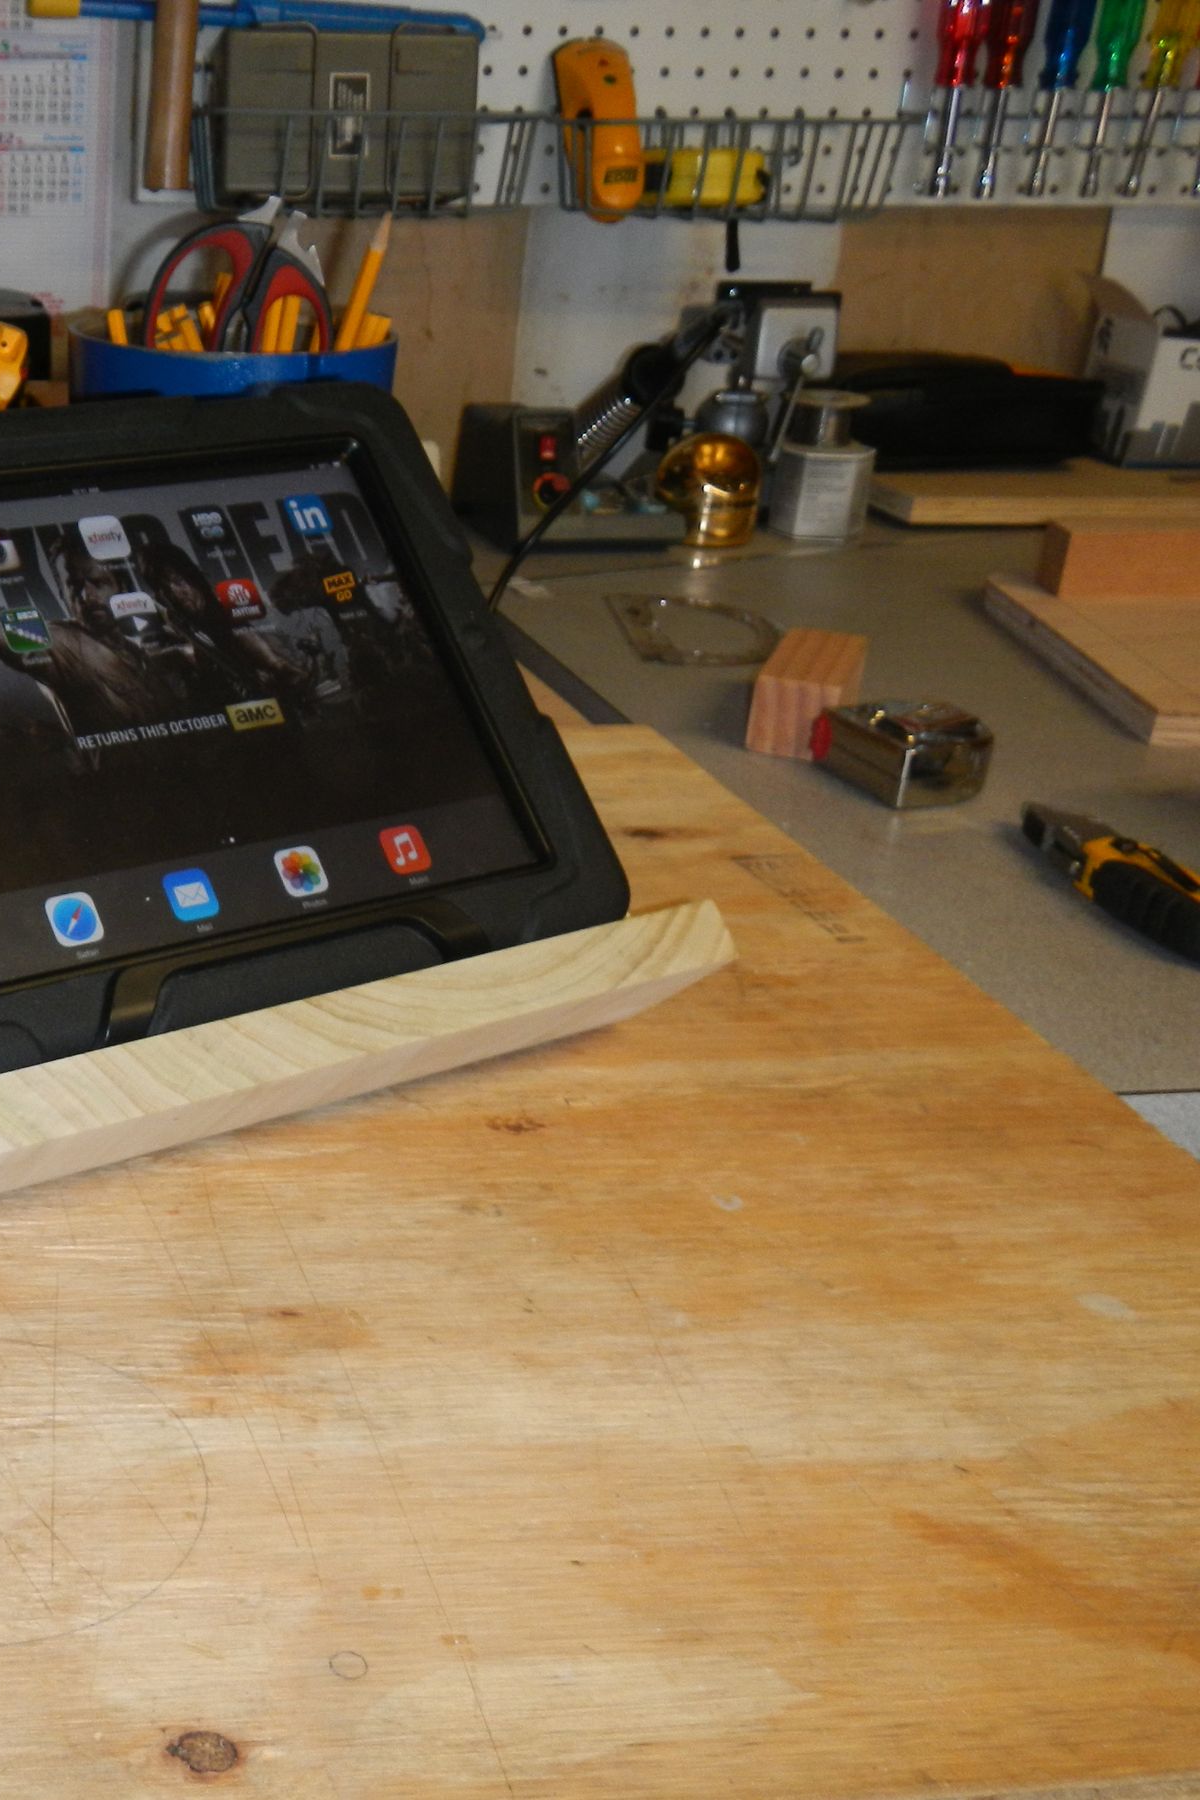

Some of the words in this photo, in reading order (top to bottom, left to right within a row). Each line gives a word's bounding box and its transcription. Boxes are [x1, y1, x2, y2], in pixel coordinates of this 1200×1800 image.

[192, 511, 222, 526] HBO
[291, 499, 328, 530] in
[88, 531, 122, 543] xfinity
[326, 574, 353, 590] MAX
[115, 598, 148, 611] xfinity
[77, 728, 138, 749] RETURNS
[138, 723, 169, 739] THIS
[171, 713, 227, 734] OCTOBER
